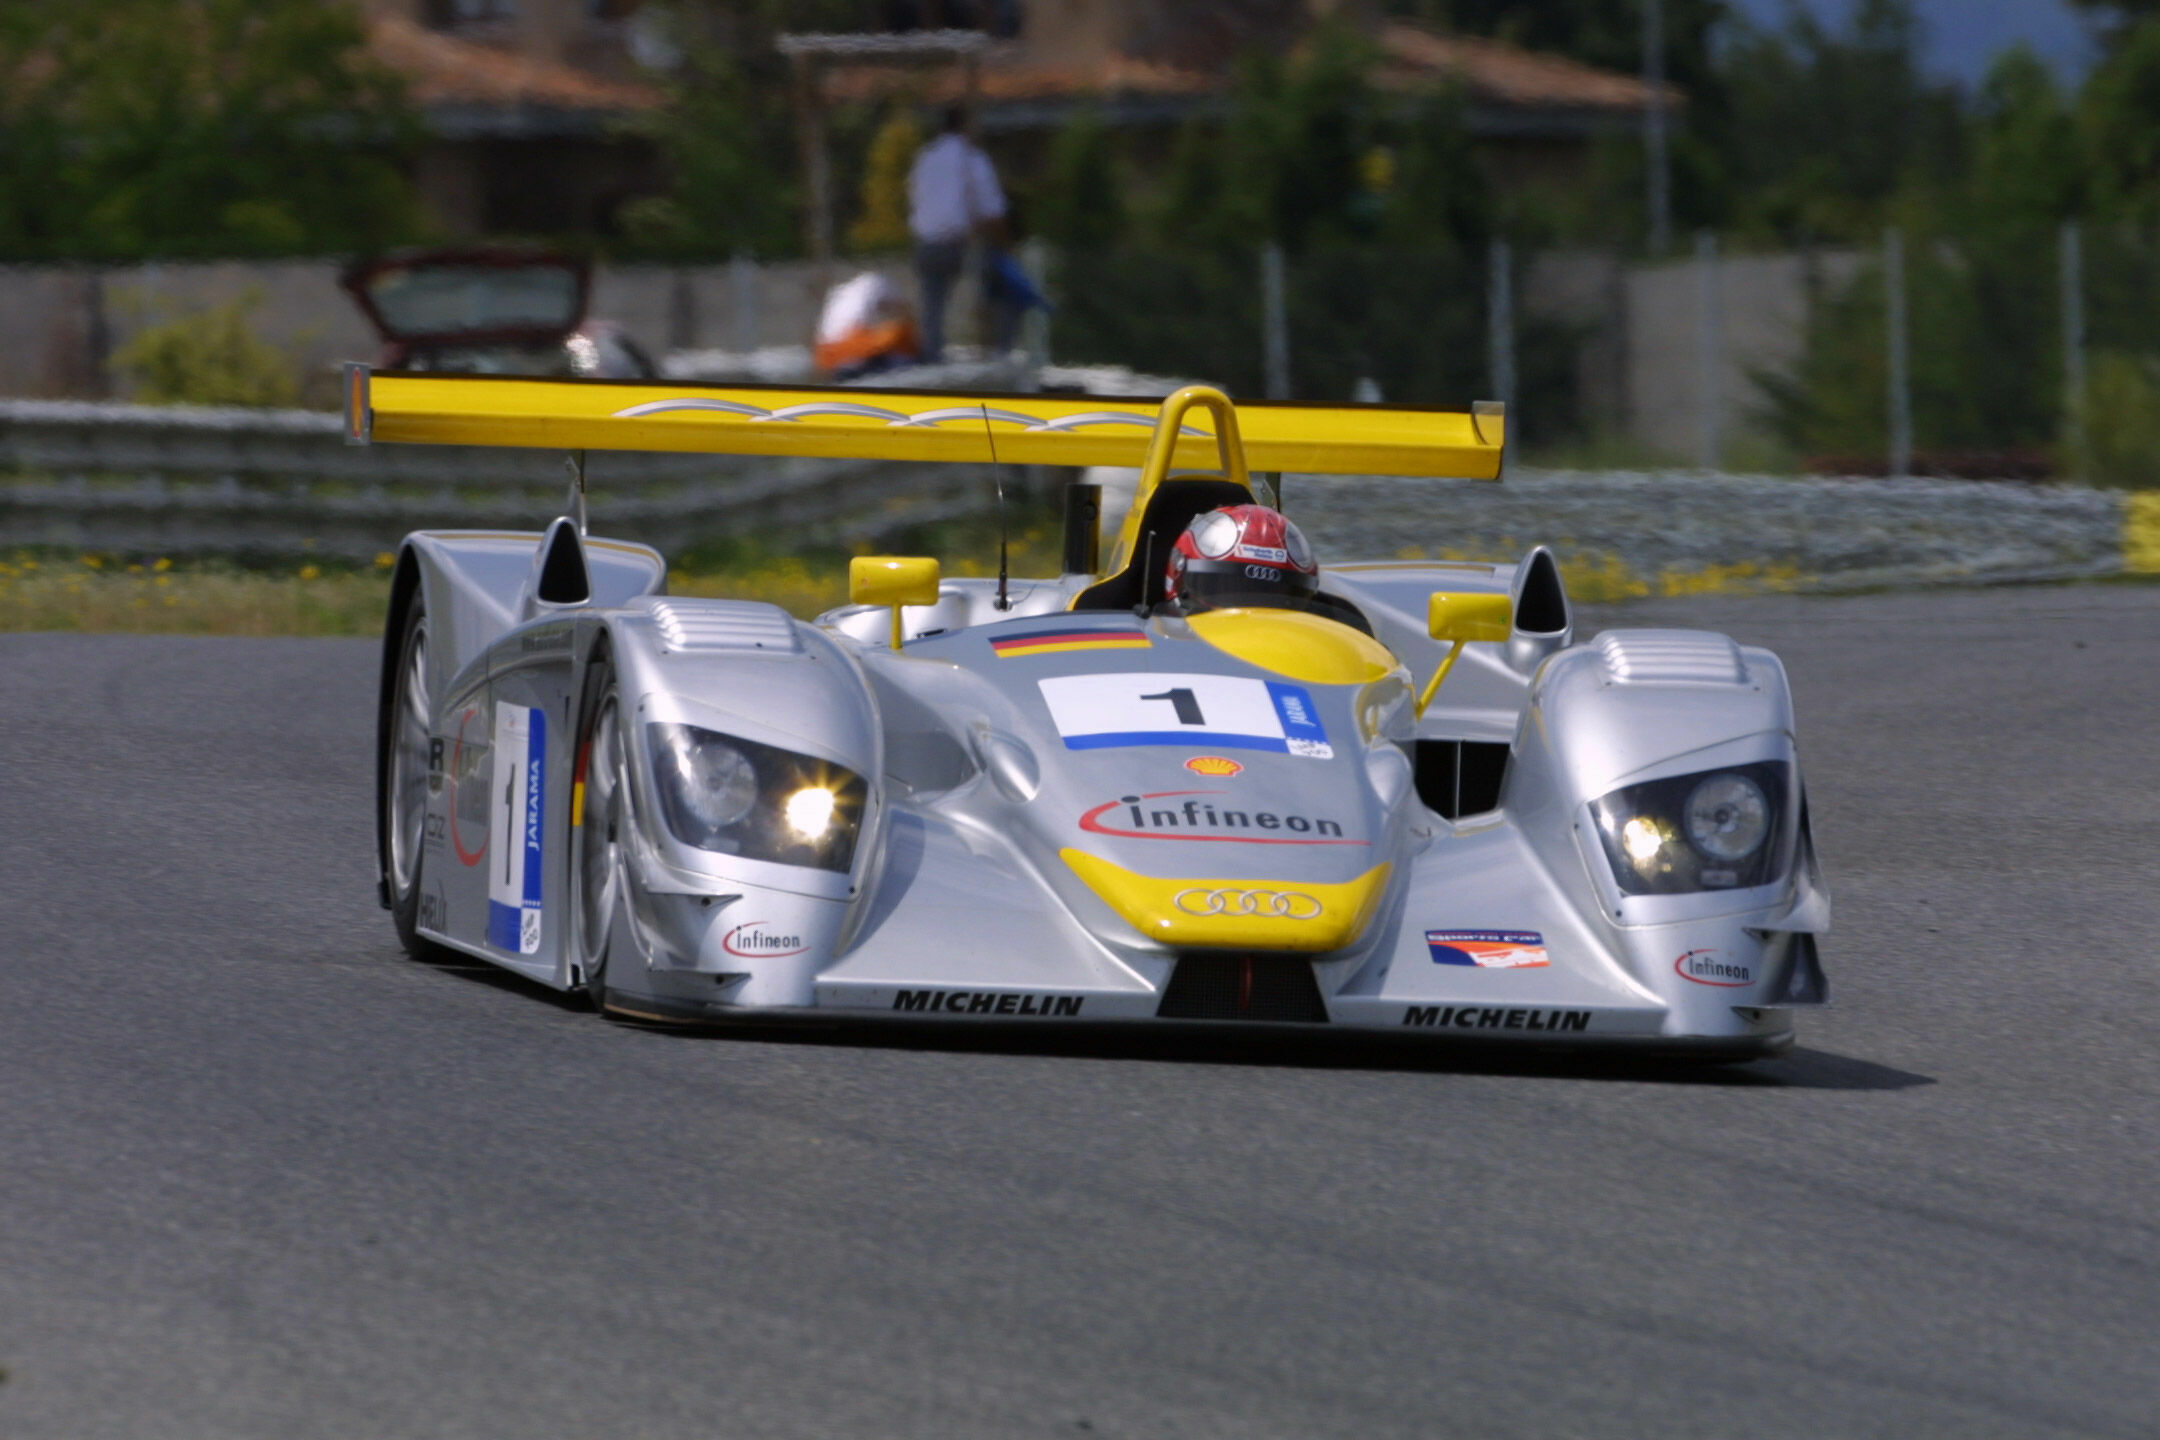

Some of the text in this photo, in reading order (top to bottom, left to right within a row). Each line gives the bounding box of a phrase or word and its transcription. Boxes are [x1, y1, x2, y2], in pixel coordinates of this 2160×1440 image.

[1140, 688, 1206, 726] 1
[527, 760, 541, 852] JARAMA
[892, 989, 1085, 1017] MICHELIN
[1401, 1005, 1592, 1032] MICHELIN
